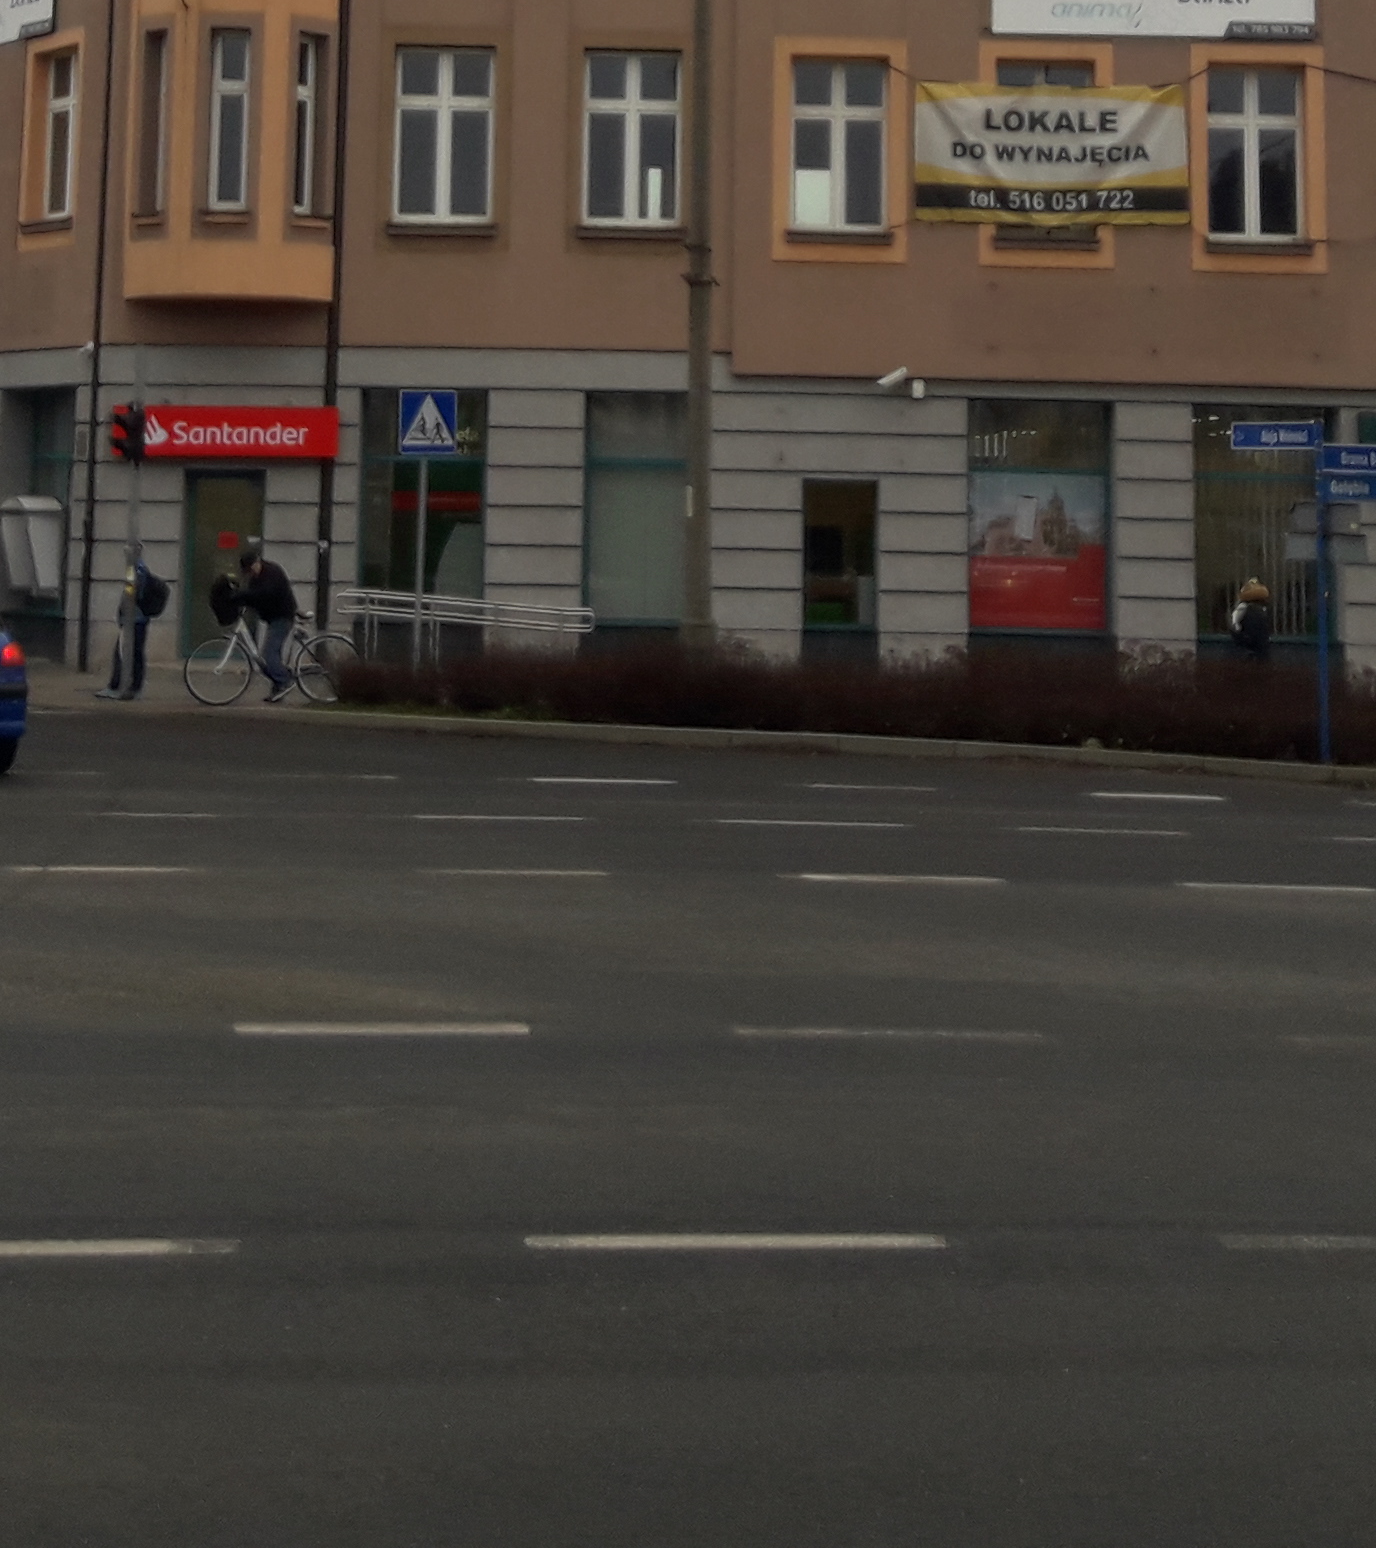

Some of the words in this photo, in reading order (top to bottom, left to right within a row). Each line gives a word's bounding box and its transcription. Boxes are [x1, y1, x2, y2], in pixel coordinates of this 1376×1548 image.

[983, 107, 1119, 134] LOKALE
[952, 142, 987, 160] DO
[995, 143, 1151, 167] WYNAJĘCIA
[968, 190, 1001, 209] tel.
[1009, 191, 1044, 211] 516
[1052, 192, 1088, 211] 051
[1096, 190, 1134, 210] 722
[172, 420, 309, 447] Santander
